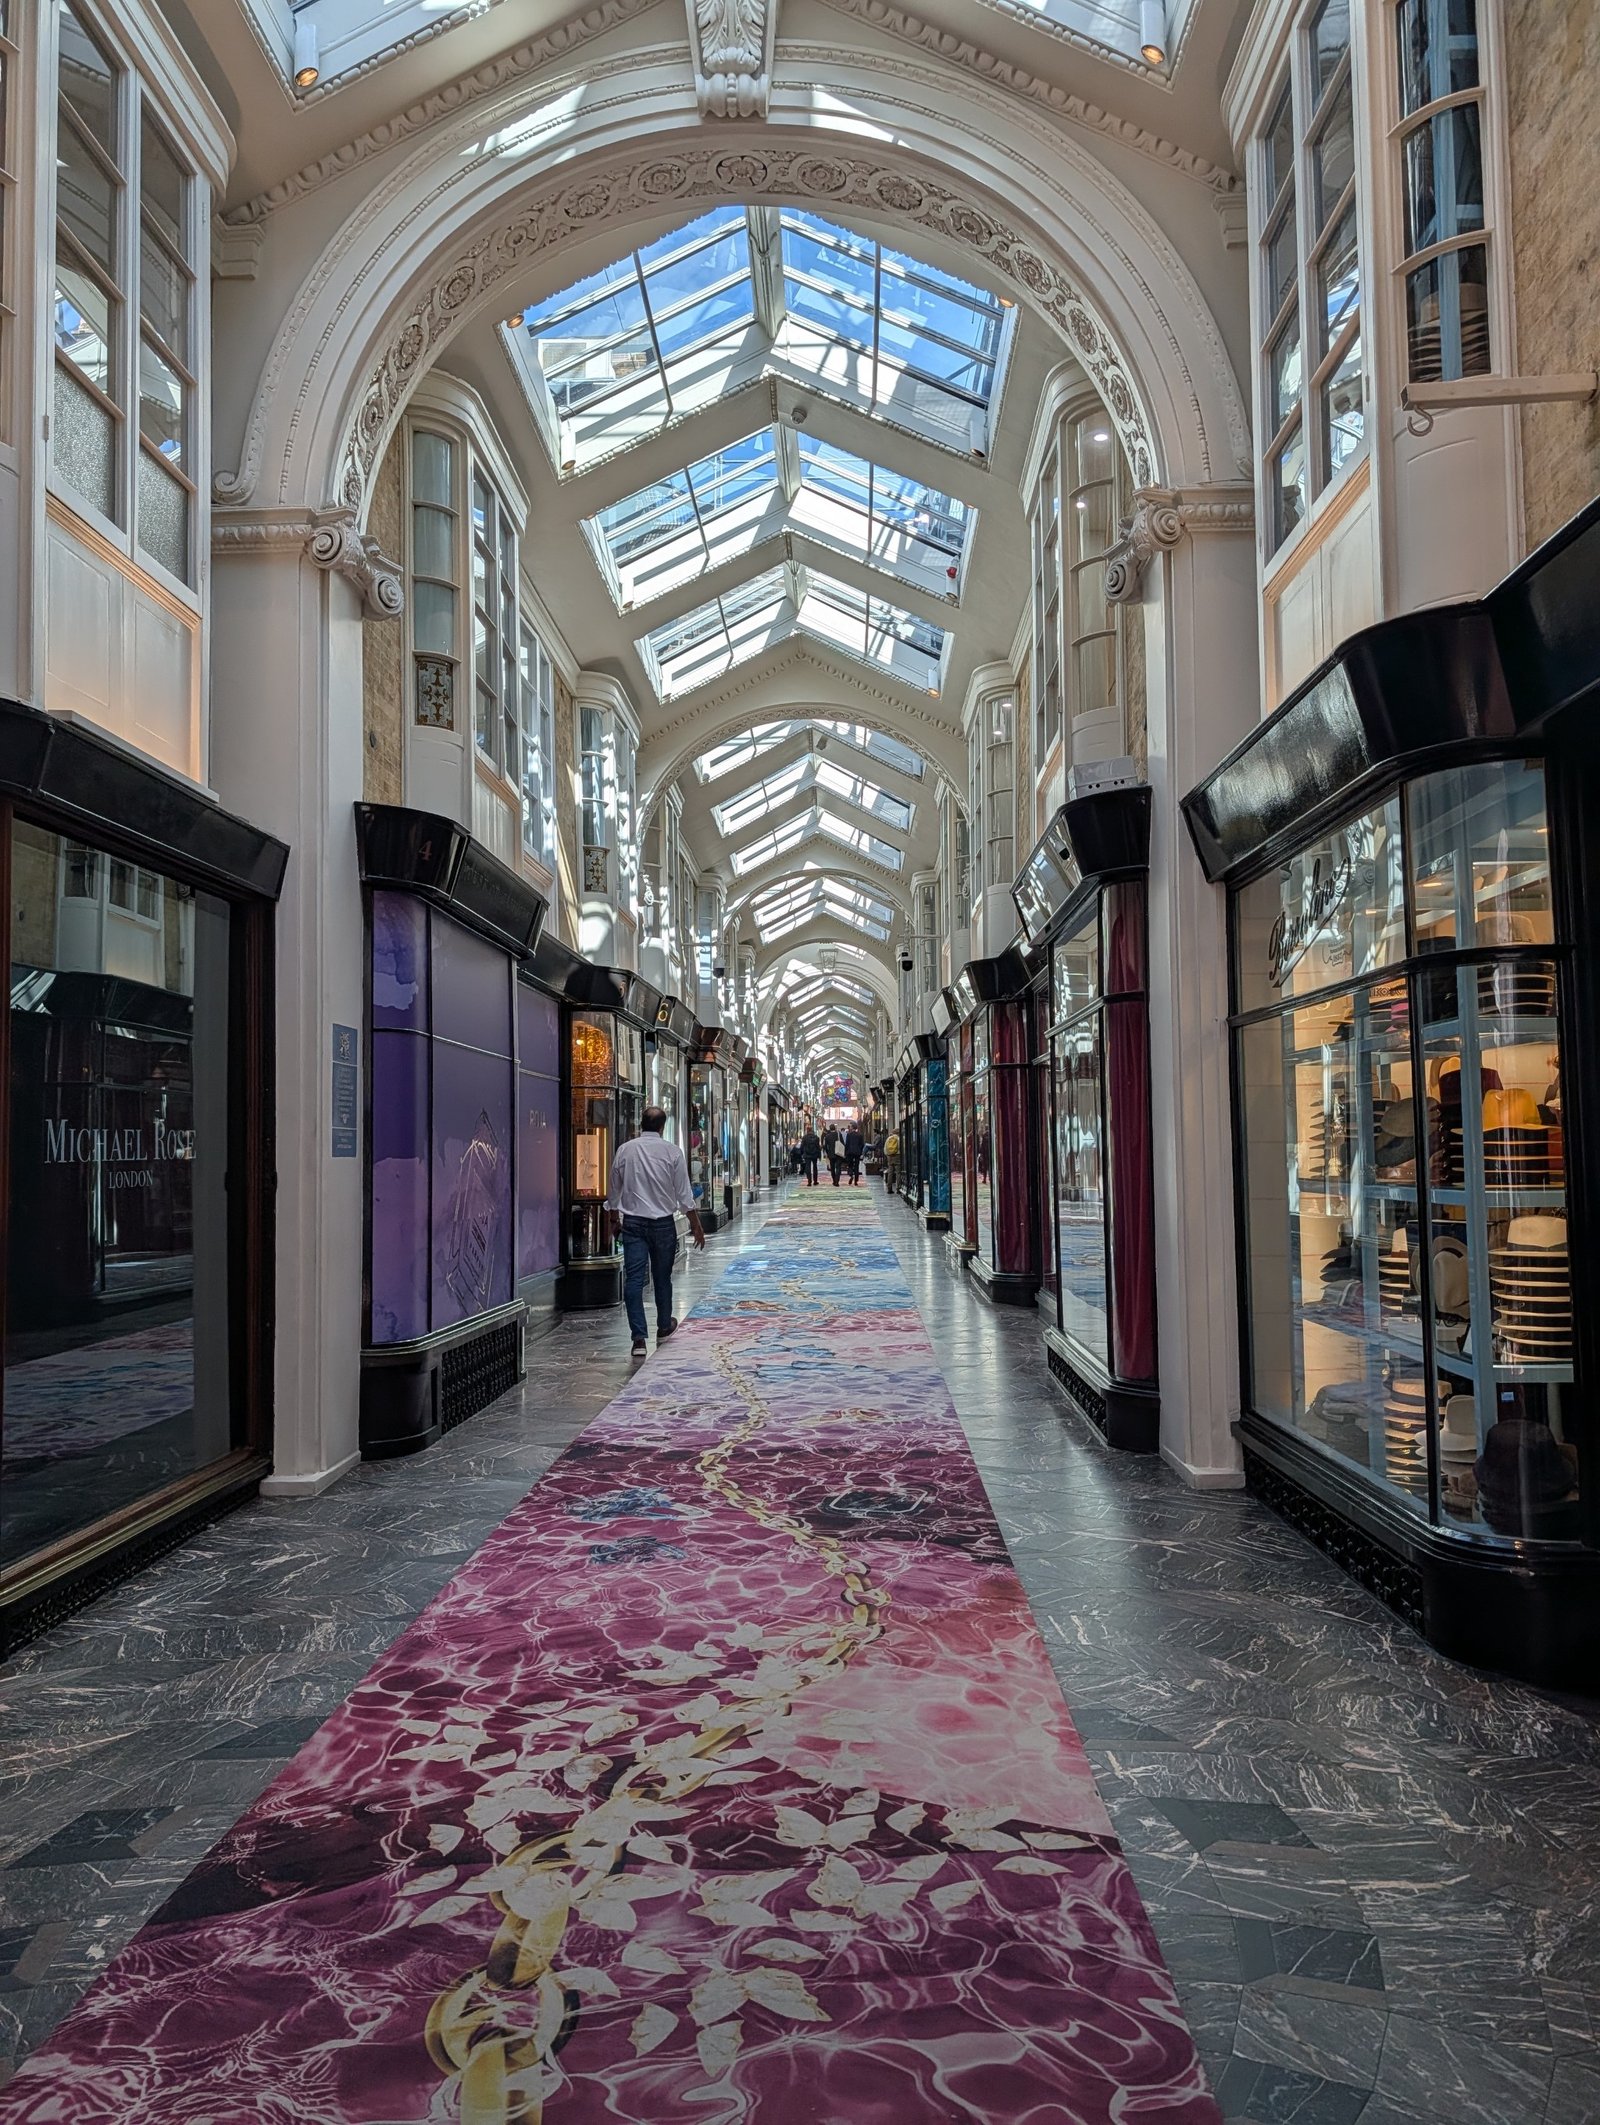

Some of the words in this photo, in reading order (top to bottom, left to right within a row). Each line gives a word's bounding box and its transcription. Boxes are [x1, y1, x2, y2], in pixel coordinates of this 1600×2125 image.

[419, 840, 433, 862] 4
[657, 1002, 669, 1022] 6
[44, 1118, 148, 1164] MICHAEL
[153, 1120, 197, 1161] ROSE
[109, 1170, 154, 1189] LONDON
